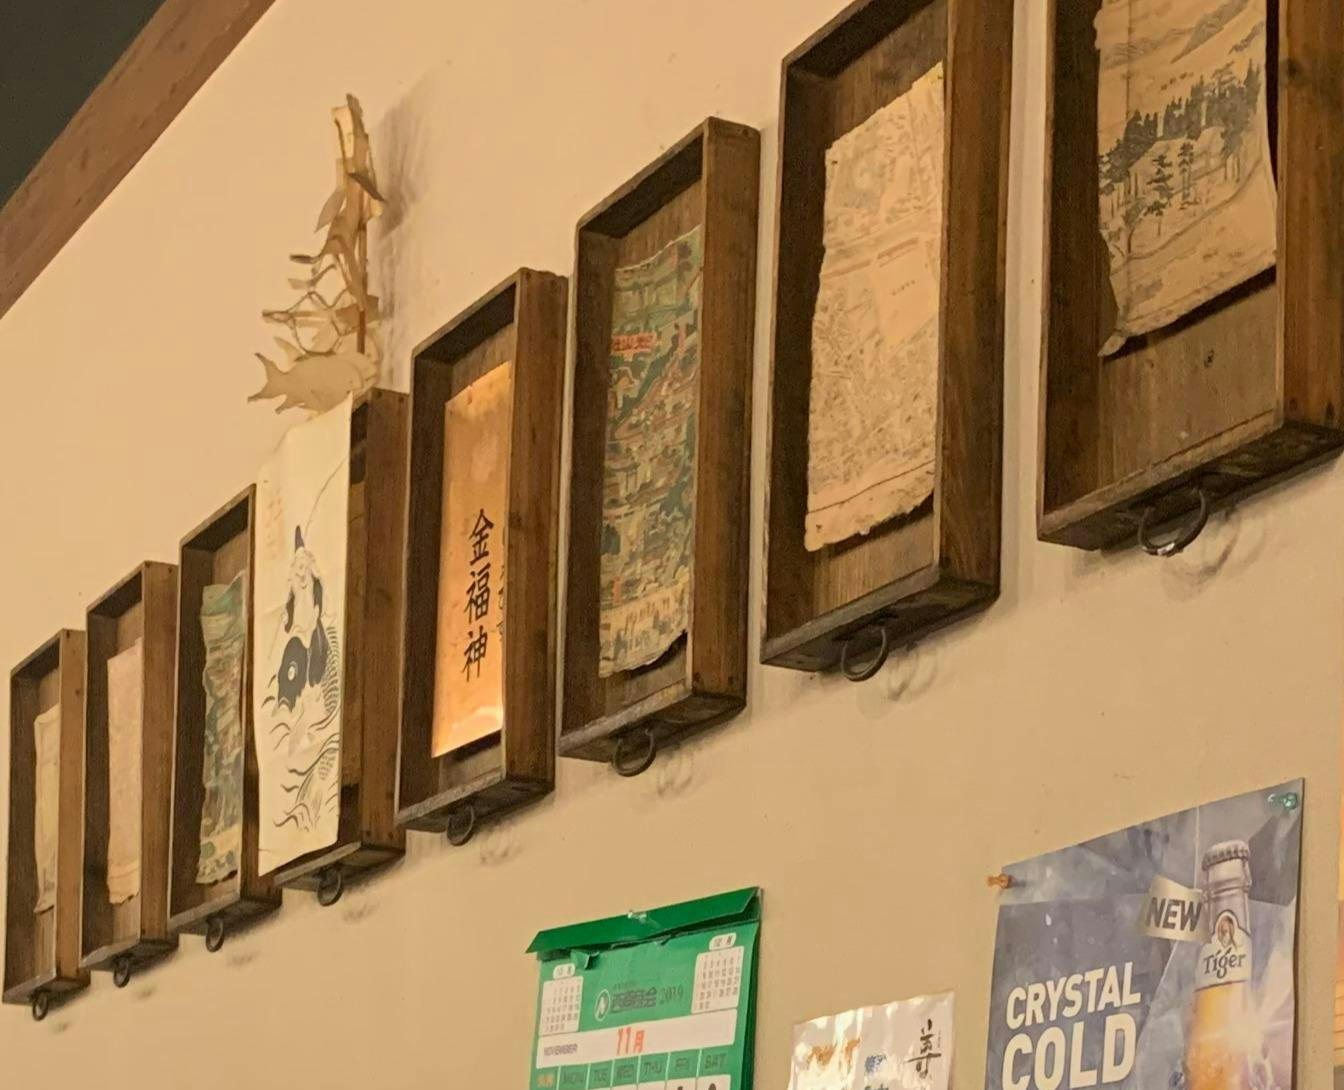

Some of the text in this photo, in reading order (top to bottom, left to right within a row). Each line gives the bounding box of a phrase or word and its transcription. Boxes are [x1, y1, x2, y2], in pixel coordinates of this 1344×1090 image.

[461, 508, 494, 683] 金福神
[1146, 896, 1203, 932] NEW
[1203, 946, 1247, 979] Tiger
[1006, 961, 1142, 1030] CRYSTAL
[705, 1053, 727, 1068] SAT
